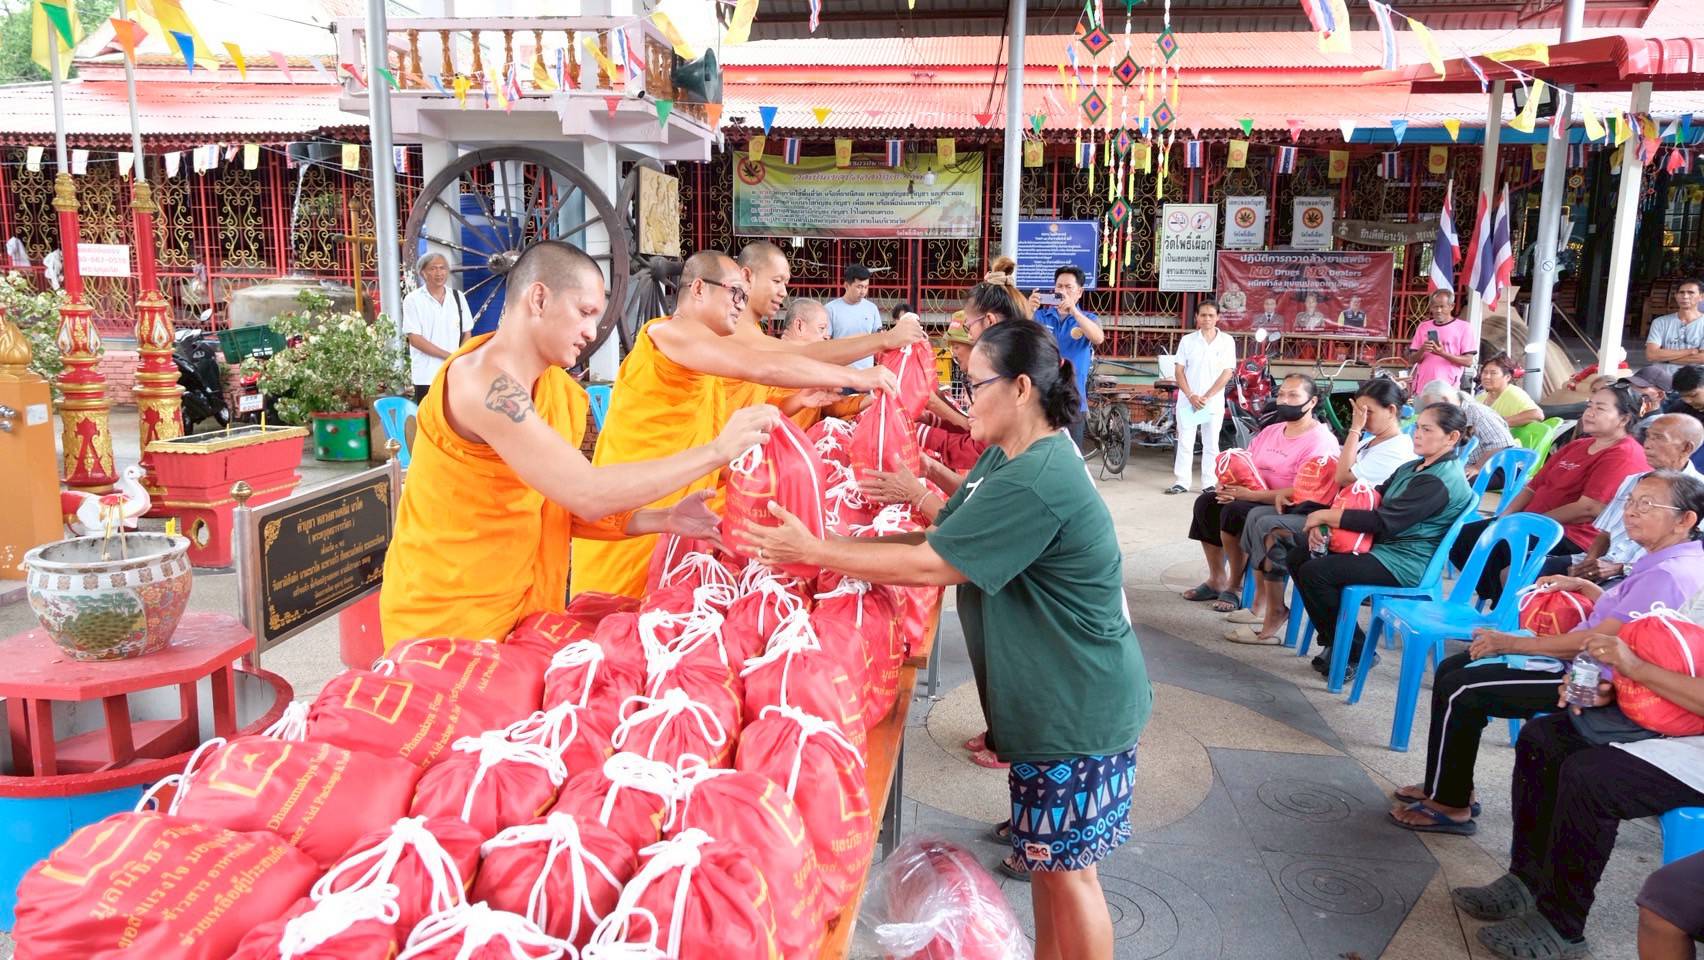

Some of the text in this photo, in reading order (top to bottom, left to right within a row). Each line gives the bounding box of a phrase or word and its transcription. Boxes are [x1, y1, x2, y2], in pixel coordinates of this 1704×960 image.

[1164, 232, 1213, 250] วัดโพธิ์เผือก
[1249, 266, 1274, 278] NO
[161, 880, 211, 921] ข้าวสาร
